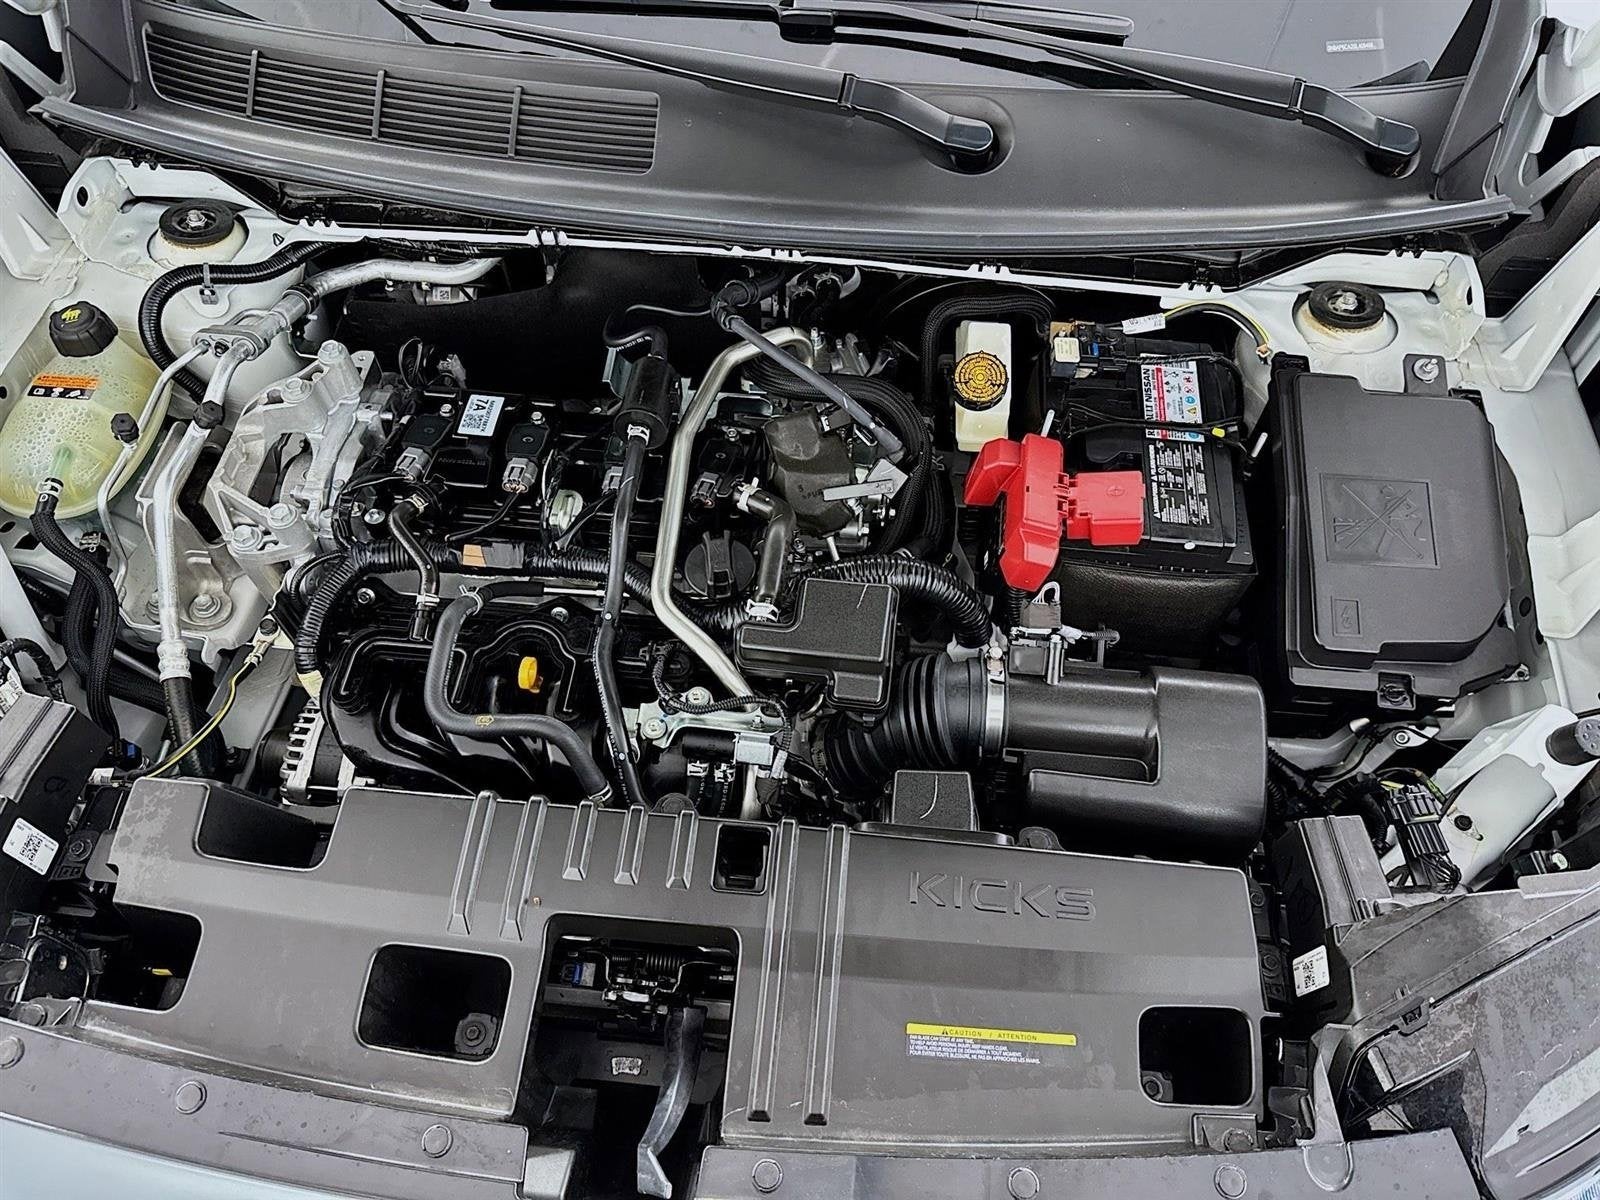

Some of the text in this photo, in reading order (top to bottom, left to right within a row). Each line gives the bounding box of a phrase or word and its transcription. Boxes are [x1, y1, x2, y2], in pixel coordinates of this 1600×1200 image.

[1142, 368, 1153, 403] NISSAN
[473, 399, 490, 411] 7A
[39, 493, 49, 502] D
[909, 871, 1096, 921] KICKS
[949, 1029, 982, 1037] CAUTION
[997, 1032, 1038, 1041] ATTENTION
